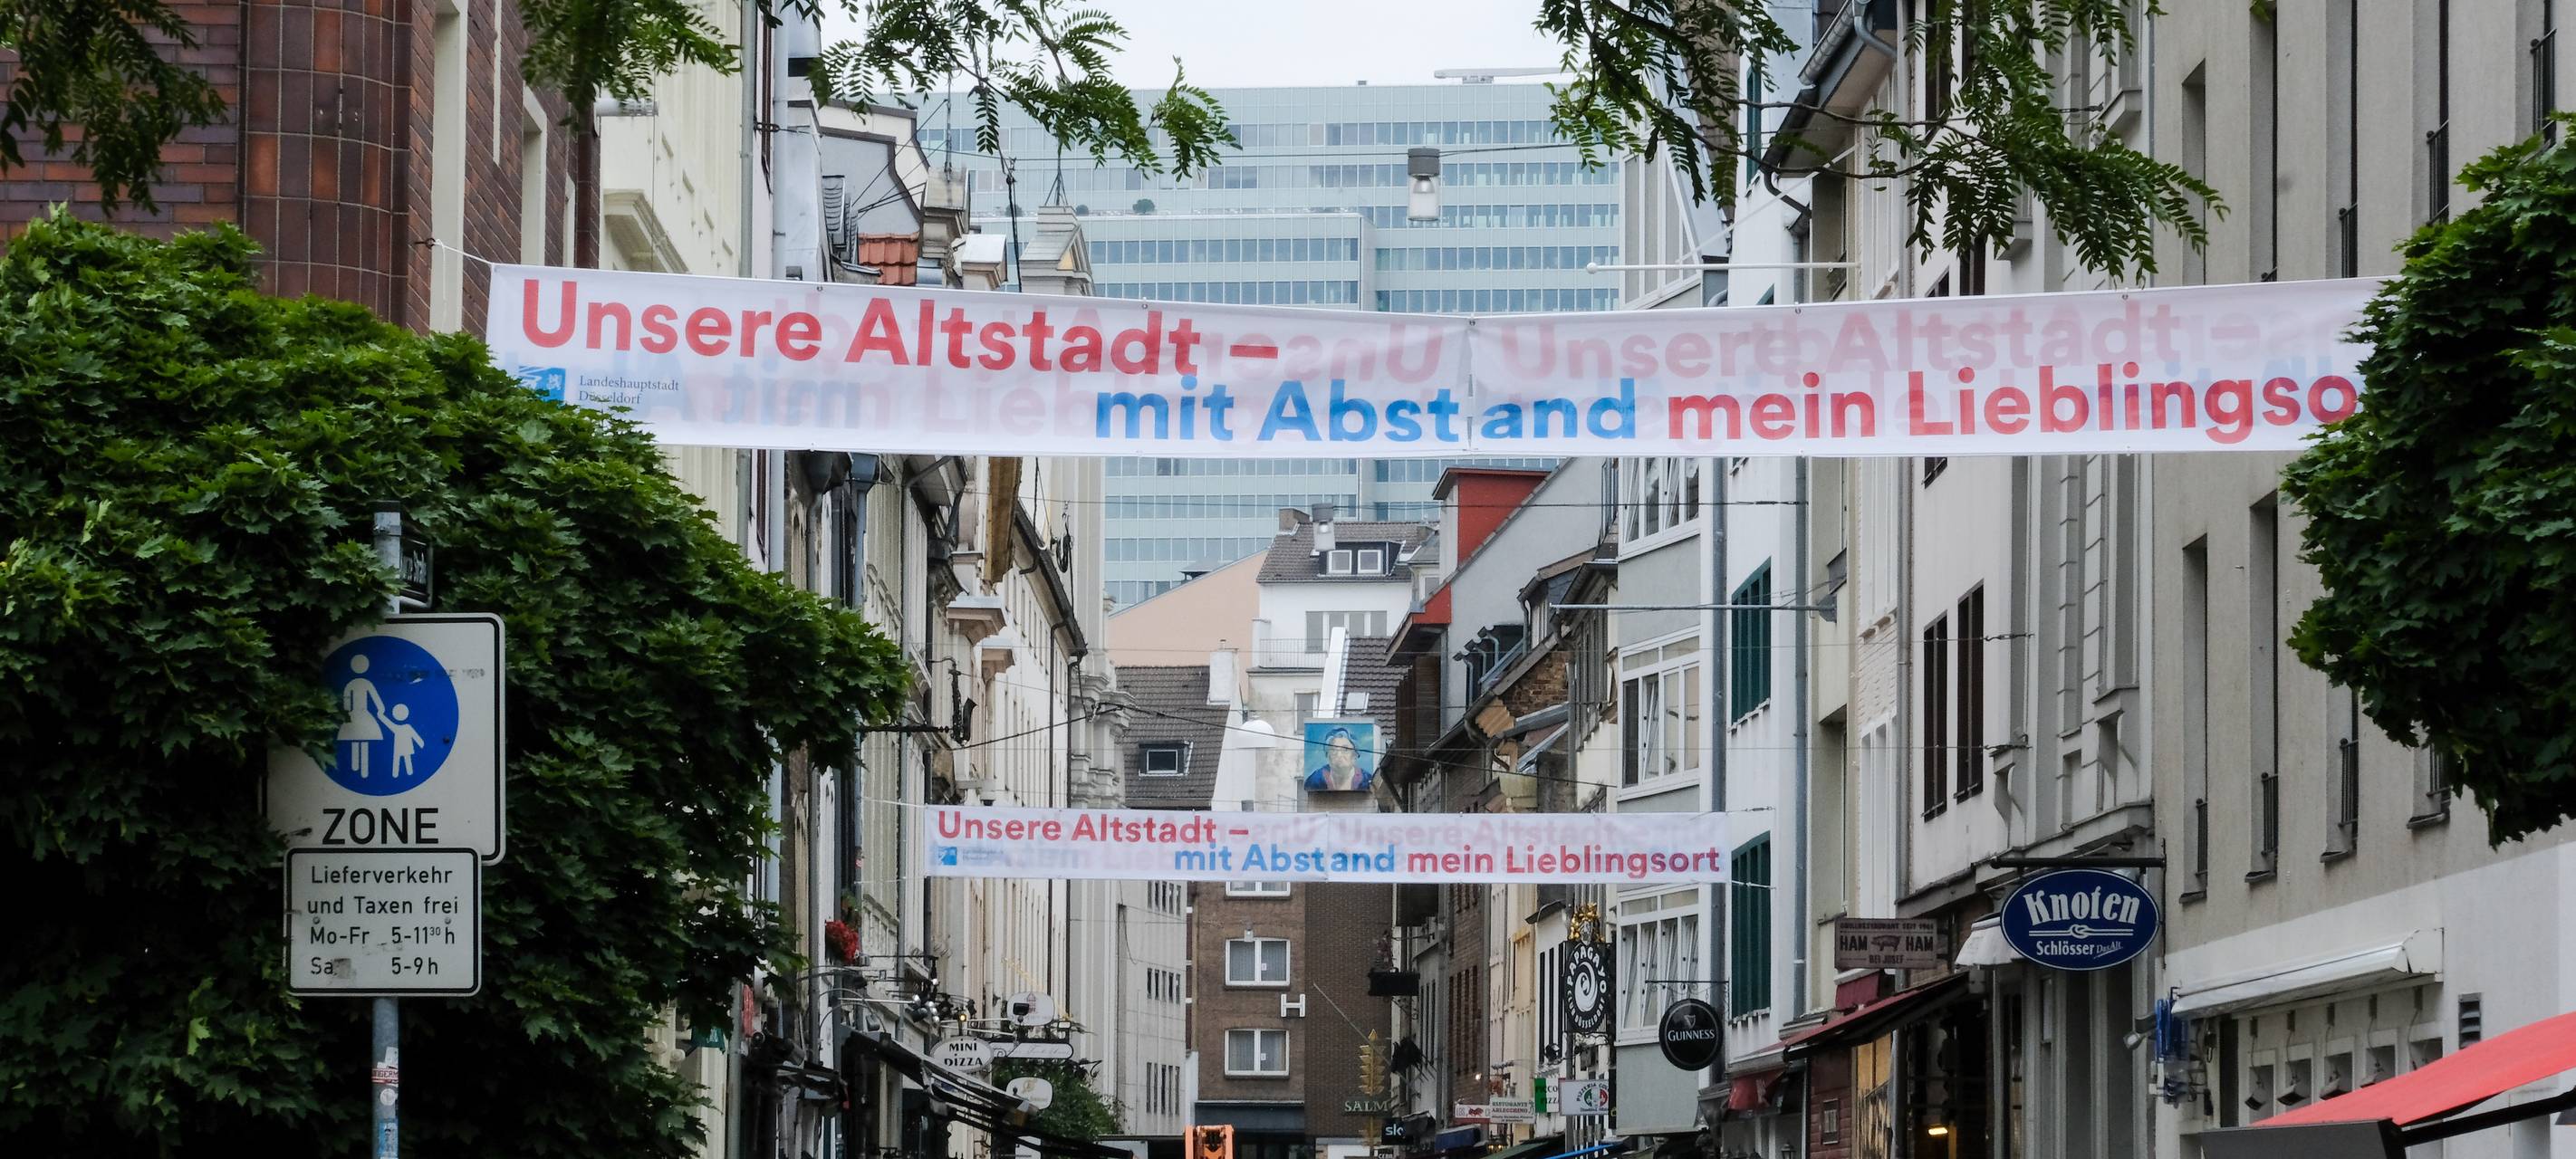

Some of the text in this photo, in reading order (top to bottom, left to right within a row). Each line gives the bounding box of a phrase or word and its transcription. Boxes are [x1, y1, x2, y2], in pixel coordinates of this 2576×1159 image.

[524, 280, 822, 361] Unsere
[847, 298, 1202, 375] Altstadt
[579, 374, 679, 393] Landeshauptstadt
[1096, 375, 1235, 440] mit
[1668, 372, 1876, 439] mein
[322, 807, 440, 846] ZONE
[939, 810, 1062, 840] Unsere
[1072, 815, 1217, 844] Altstadt
[1174, 842, 1233, 872] mit
[1407, 843, 1494, 874] mein
[1505, 845, 1720, 879] Lieblingsort
[311, 865, 454, 885] Lieferverkehr
[307, 896, 458, 915] und Taxen frei
[2023, 885, 2141, 926] Knoten
[310, 926, 370, 944] Mo-Fr
[1840, 934, 1934, 952] HAM HAM
[2035, 940, 2095, 956] Schlösser
[1566, 945, 1607, 994] PAPAGAYO
[1280, 993, 1306, 1018] H
[1667, 1030, 1716, 1042] GUINNESS
[1344, 1100, 1389, 1112] SALM
